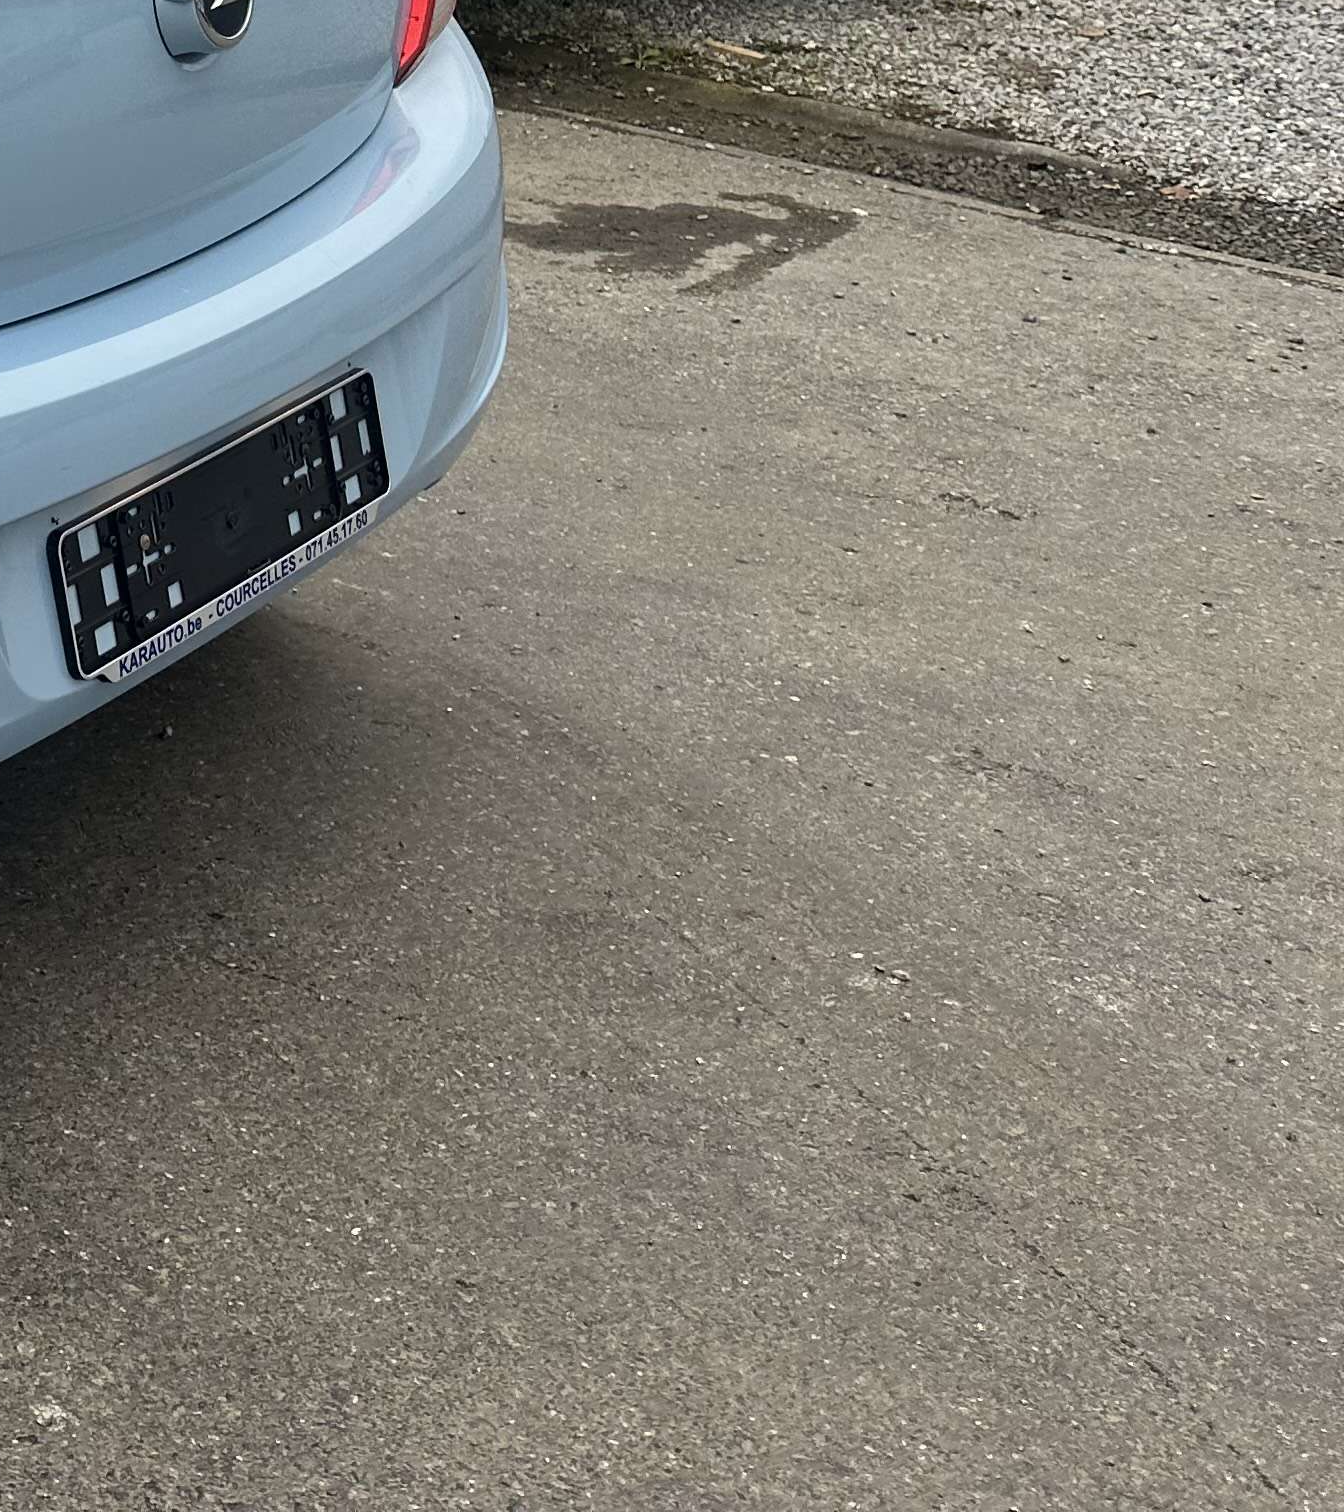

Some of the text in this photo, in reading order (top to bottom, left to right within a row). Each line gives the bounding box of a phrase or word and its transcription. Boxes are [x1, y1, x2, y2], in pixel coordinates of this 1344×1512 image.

[119, 615, 202, 677] KARAUTO.be
[216, 555, 297, 618] COURCELLES
[305, 509, 368, 562] 071.45.17.60
